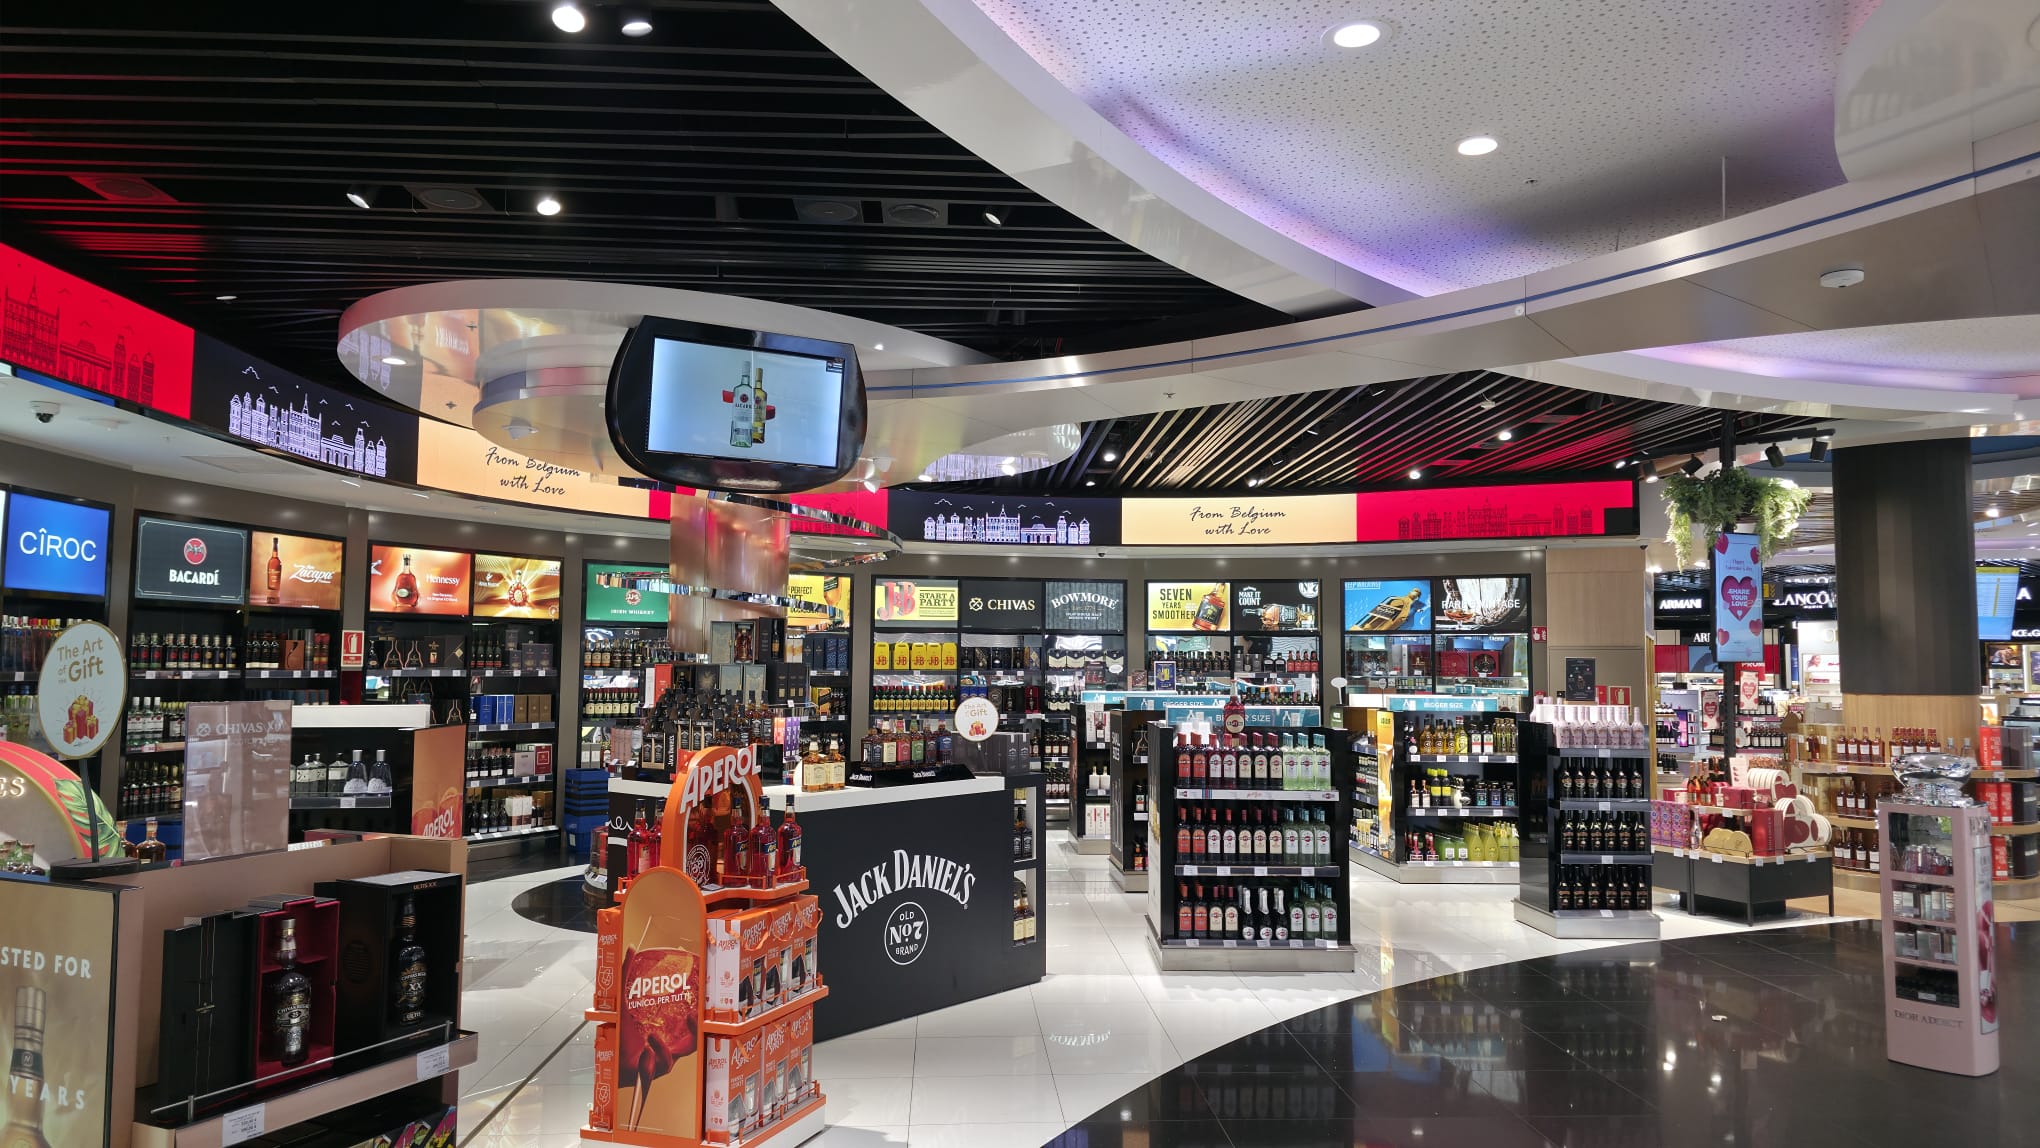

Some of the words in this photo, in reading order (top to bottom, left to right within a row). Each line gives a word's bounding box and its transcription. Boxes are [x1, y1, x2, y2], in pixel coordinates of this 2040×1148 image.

[485, 447, 519, 466] From
[500, 475, 528, 489] with
[532, 477, 565, 495] Love
[1190, 506, 1224, 521] From
[1230, 506, 1286, 523] Belgium
[1205, 523, 1234, 535] with
[1238, 521, 1271, 535] Love
[19, 528, 97, 562] CÎROC
[169, 569, 220, 586] BACARDÍ
[425, 573, 460, 586] Hennessy
[1051, 592, 1120, 610] BOWMORE
[1160, 588, 1192, 601] SEVEN
[920, 599, 956, 607] PARTY
[988, 599, 1035, 611] CHIVAS
[1239, 598, 1261, 606] COUNT
[1659, 599, 1702, 610] ARMANI
[1152, 610, 1196, 620] SMOOTHER
[57, 644, 79, 662] The
[82, 637, 104, 654] Art
[68, 656, 104, 682] Gift
[1251, 714, 1271, 722] SIZE
[216, 722, 263, 735] CHIVAS
[680, 743, 761, 814] APEROL
[833, 862, 893, 928] JACK
[893, 849, 976, 904] DANIEL'S
[899, 911, 915, 921] OLD
[895, 943, 919, 956] BRAND
[0, 946, 46, 971] STED
[54, 955, 92, 979] FOR
[628, 972, 691, 999] APEROL
[657, 995, 670, 1004] PER
[1894, 1009, 1919, 1021] DIOR
[10, 1074, 85, 1110] YEARS
